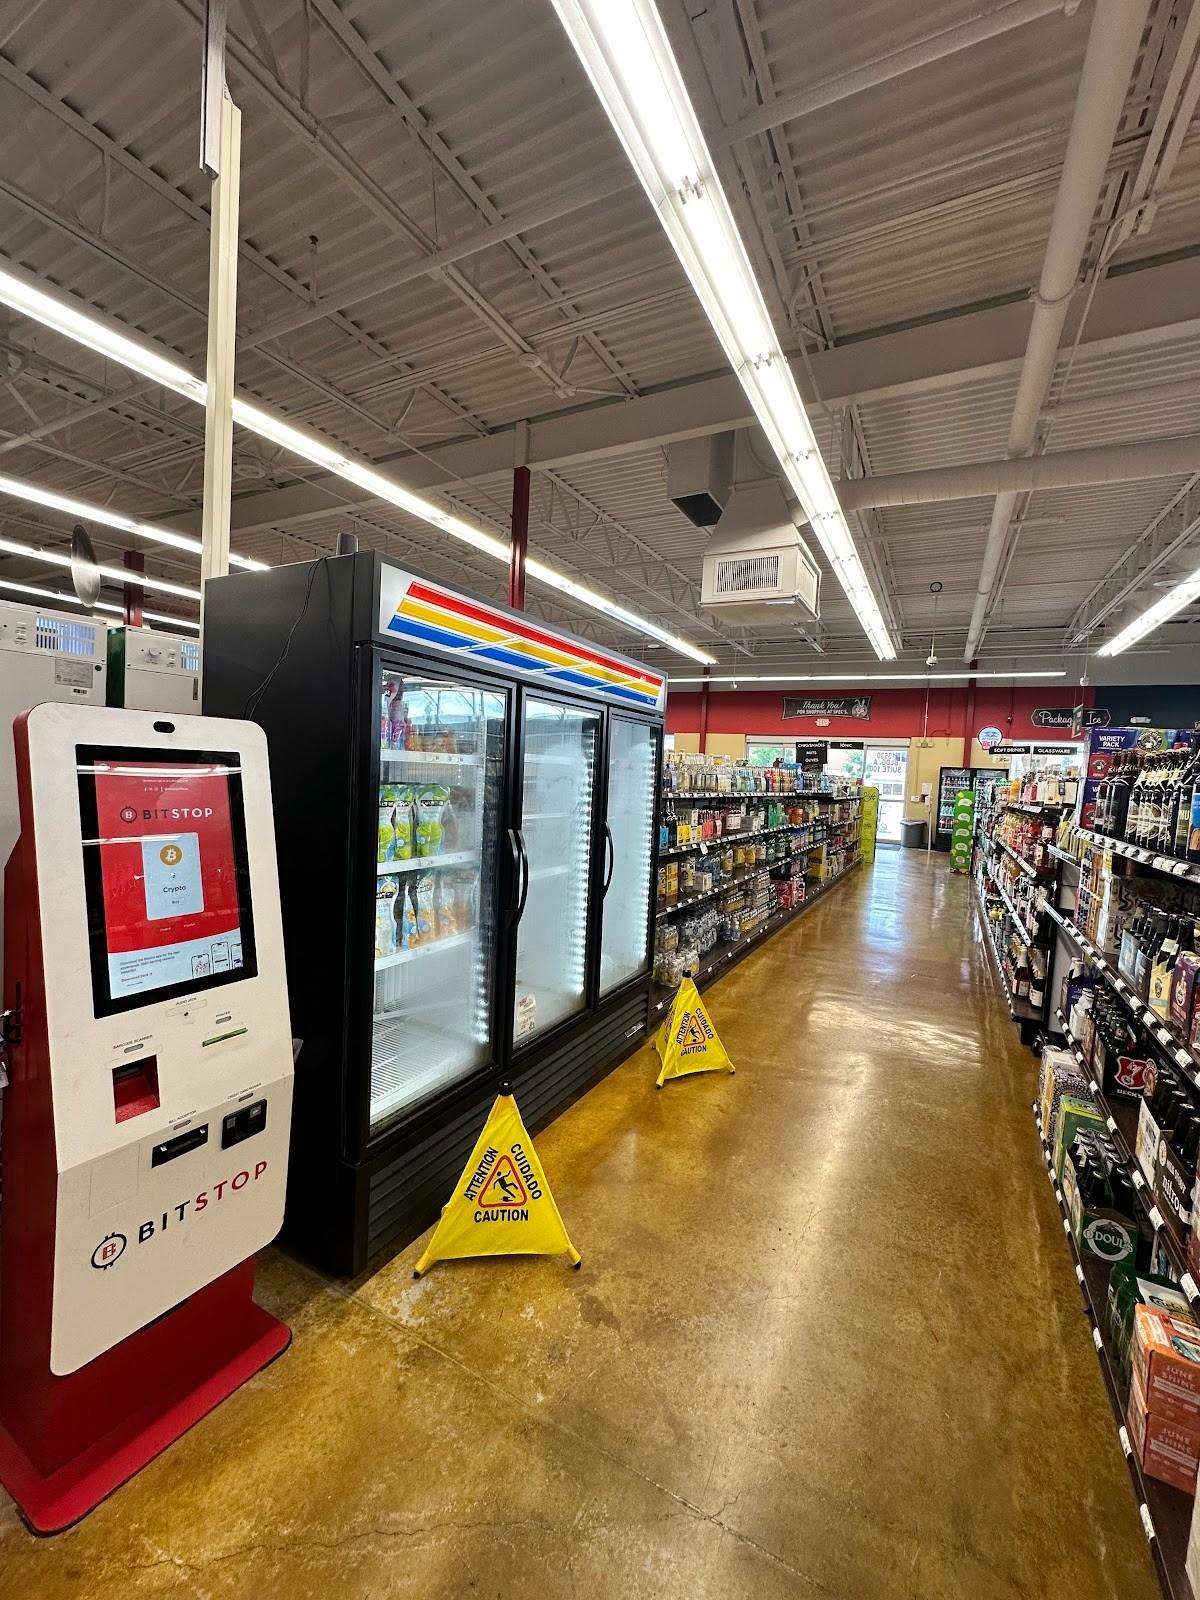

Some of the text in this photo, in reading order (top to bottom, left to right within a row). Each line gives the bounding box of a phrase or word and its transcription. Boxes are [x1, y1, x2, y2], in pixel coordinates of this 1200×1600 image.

[802, 700, 844, 709] Thank You!
[1038, 710, 1102, 727] Packag Ice
[142, 807, 213, 820] BITSTOP
[162, 884, 187, 894] Crypto
[676, 1011, 691, 1045] ATTENTION
[695, 1007, 714, 1040] CUIDADO
[680, 1045, 707, 1056] CAUTION
[463, 1146, 499, 1202] ATTENTION
[510, 1143, 543, 1200] CUIDADO
[138, 1161, 267, 1244] BITSTOP
[473, 1208, 529, 1223] CAUTION
[1161, 1371, 1197, 1391] SHINE
[1165, 1364, 1195, 1381] JUNE
[1157, 1434, 1193, 1456] SHINE
[1161, 1427, 1191, 1445] JUNE
